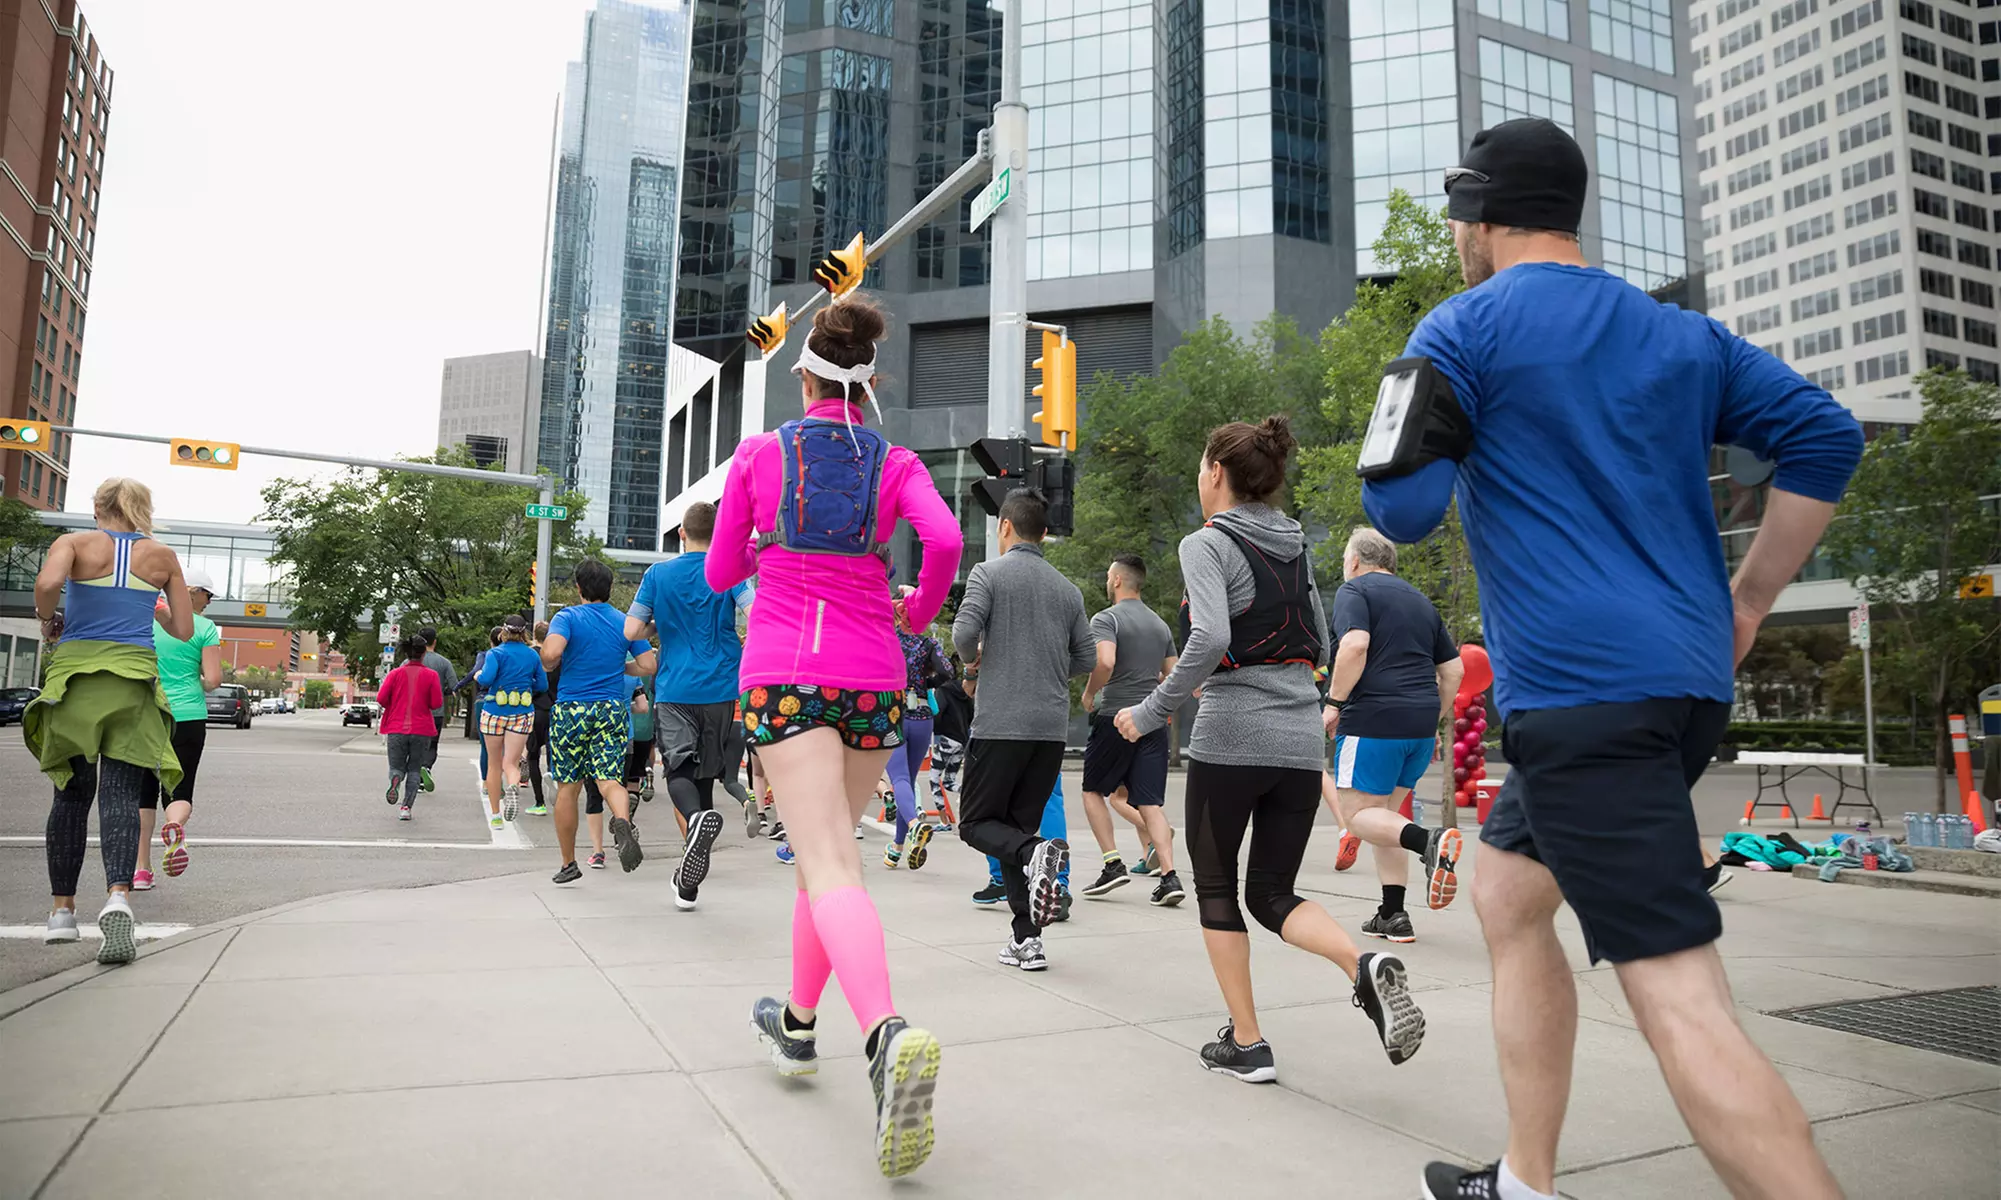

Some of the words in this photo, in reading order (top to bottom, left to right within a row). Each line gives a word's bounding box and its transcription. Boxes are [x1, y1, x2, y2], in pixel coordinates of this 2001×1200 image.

[529, 506, 535, 515] 4
[538, 507, 549, 517] ST
[552, 508, 564, 518] SW
